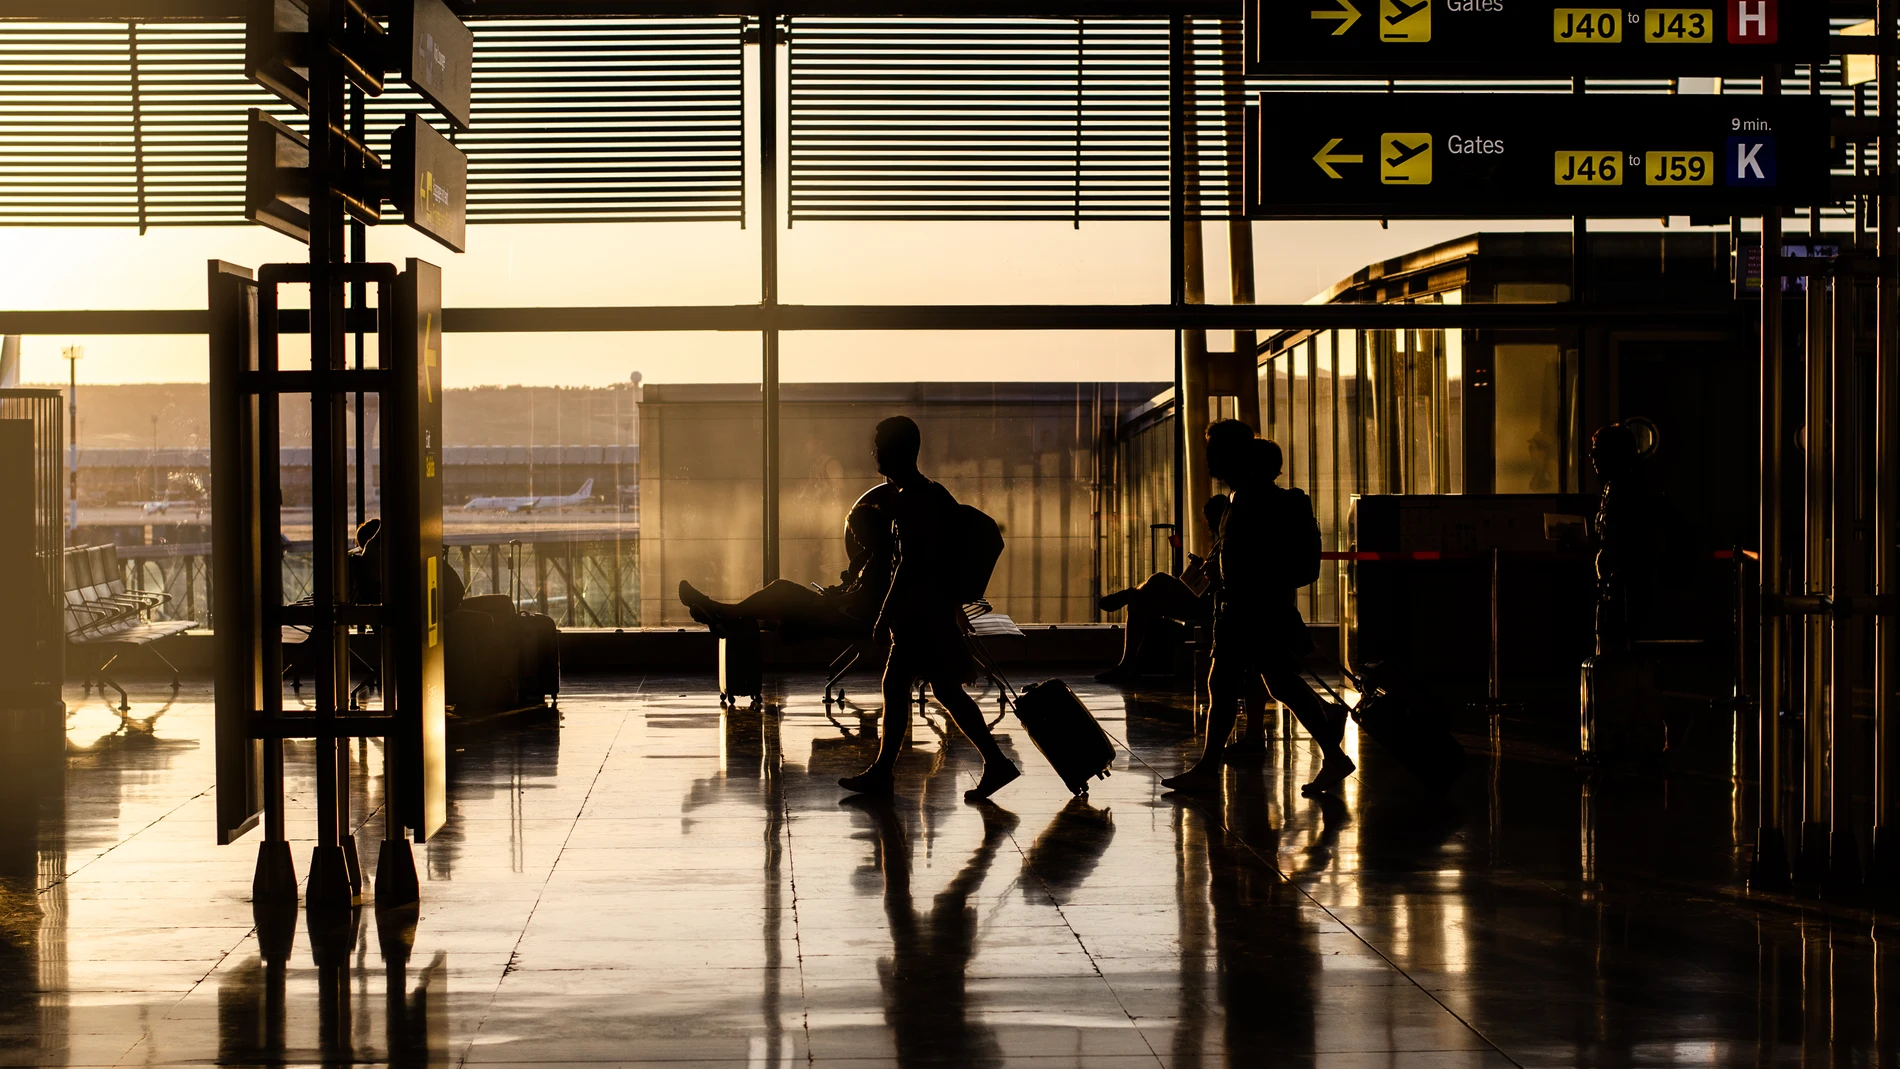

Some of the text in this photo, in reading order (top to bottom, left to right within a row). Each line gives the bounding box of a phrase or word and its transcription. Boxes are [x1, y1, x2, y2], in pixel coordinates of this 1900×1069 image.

[1447, 0, 1504, 12] Gates
[1738, 0, 1766, 36] H
[1560, 11, 1705, 39] J40 to J43
[1731, 117, 1772, 131] 9 min.
[1447, 134, 1505, 154] Gates
[1561, 154, 1706, 181] J46 to J59
[1737, 143, 1765, 179] K
